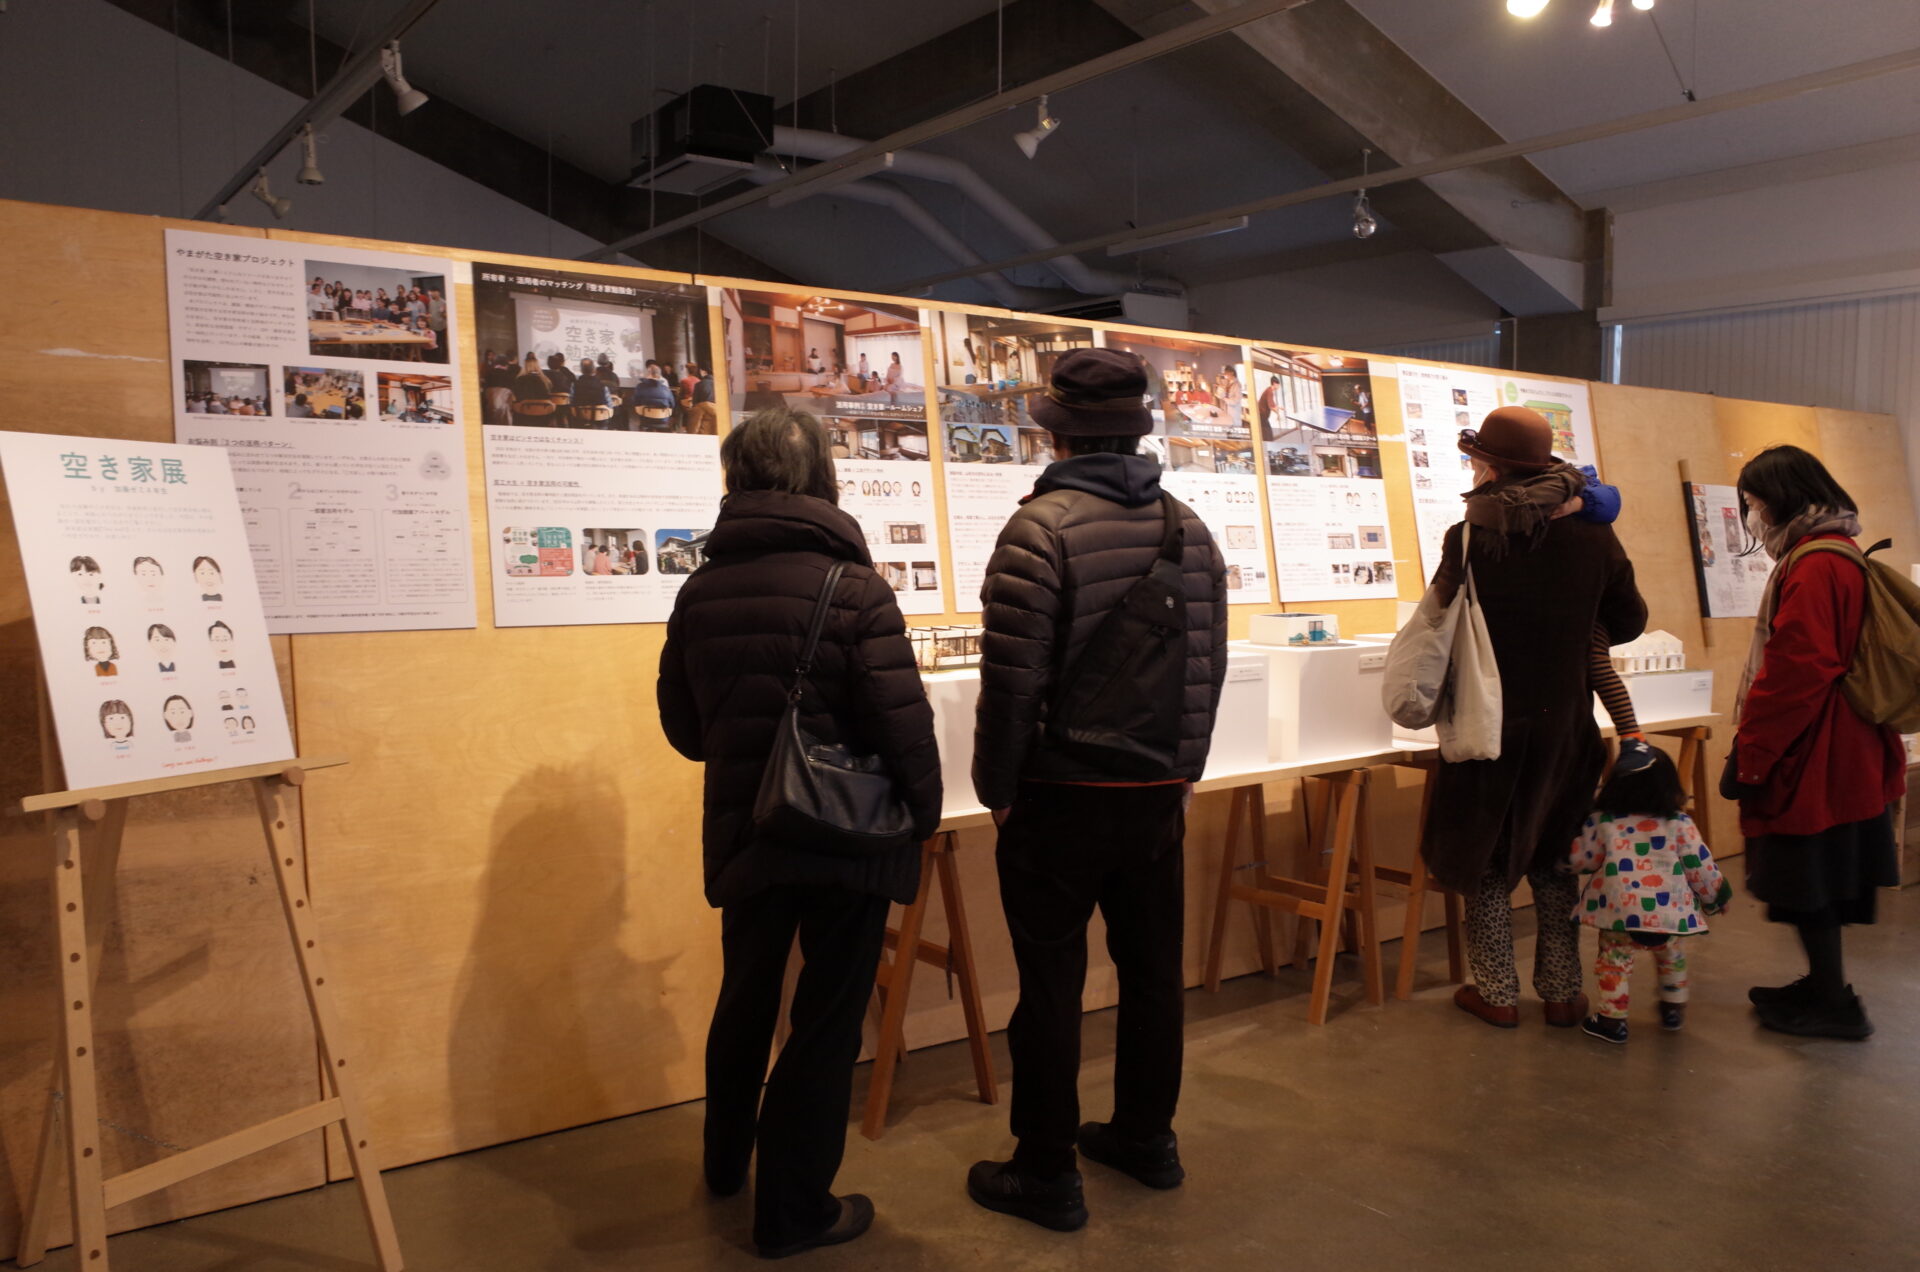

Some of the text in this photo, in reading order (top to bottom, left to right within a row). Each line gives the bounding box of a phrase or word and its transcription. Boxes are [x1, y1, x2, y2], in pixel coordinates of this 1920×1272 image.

[176, 248, 295, 268] やまがた空き家プロジェクト
[565, 325, 616, 346] 空き家
[59, 451, 188, 485] 空き家展
[288, 481, 303, 500] 2
[386, 484, 399, 501] 3
